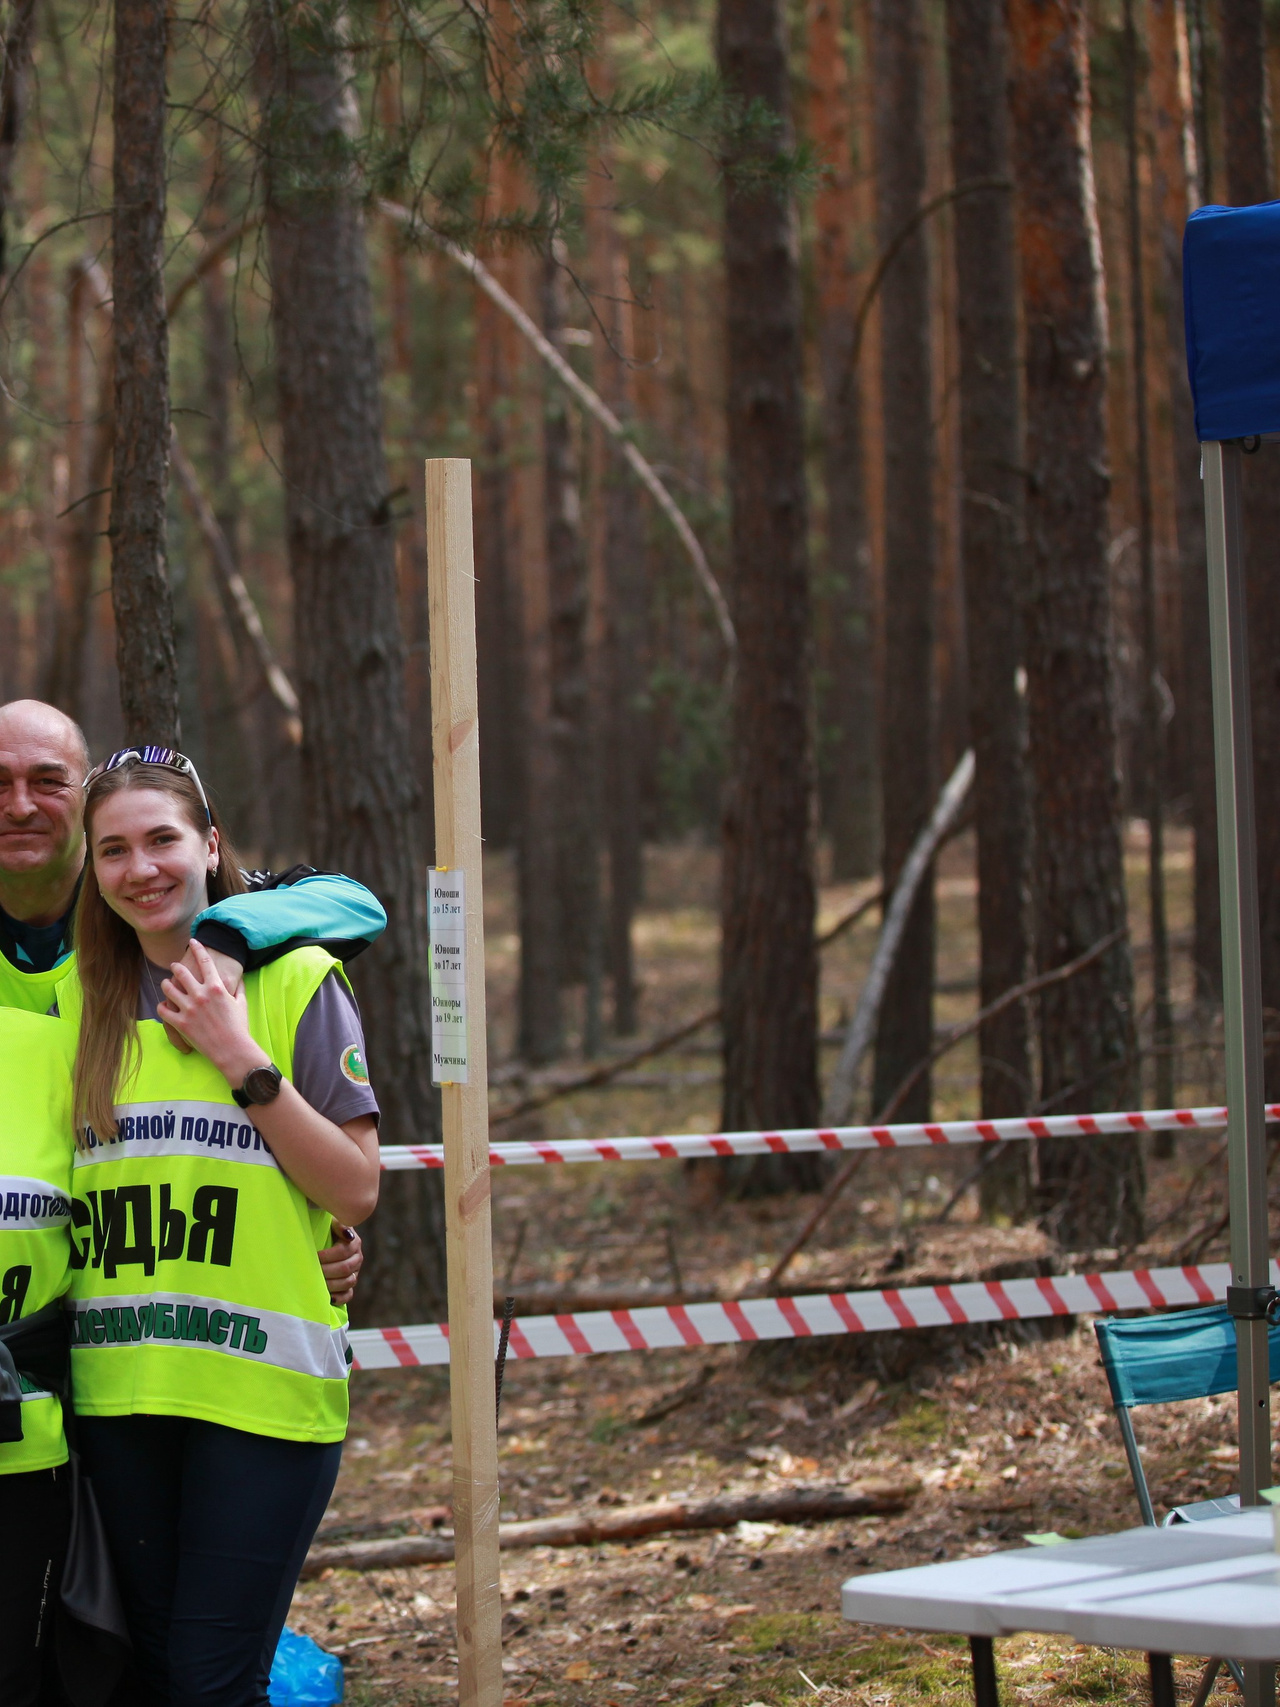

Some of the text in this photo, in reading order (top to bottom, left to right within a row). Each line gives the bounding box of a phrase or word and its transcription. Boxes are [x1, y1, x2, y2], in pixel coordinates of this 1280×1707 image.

[434, 887, 460, 899] Юноши
[432, 903, 461, 914] до 15 лет
[434, 943, 460, 955] Юноши
[434, 960, 461, 970] до 17 лет
[443, 1012, 451, 1023] 19
[451, 1015, 463, 1023] лет
[433, 1053, 467, 1066] Мужчины
